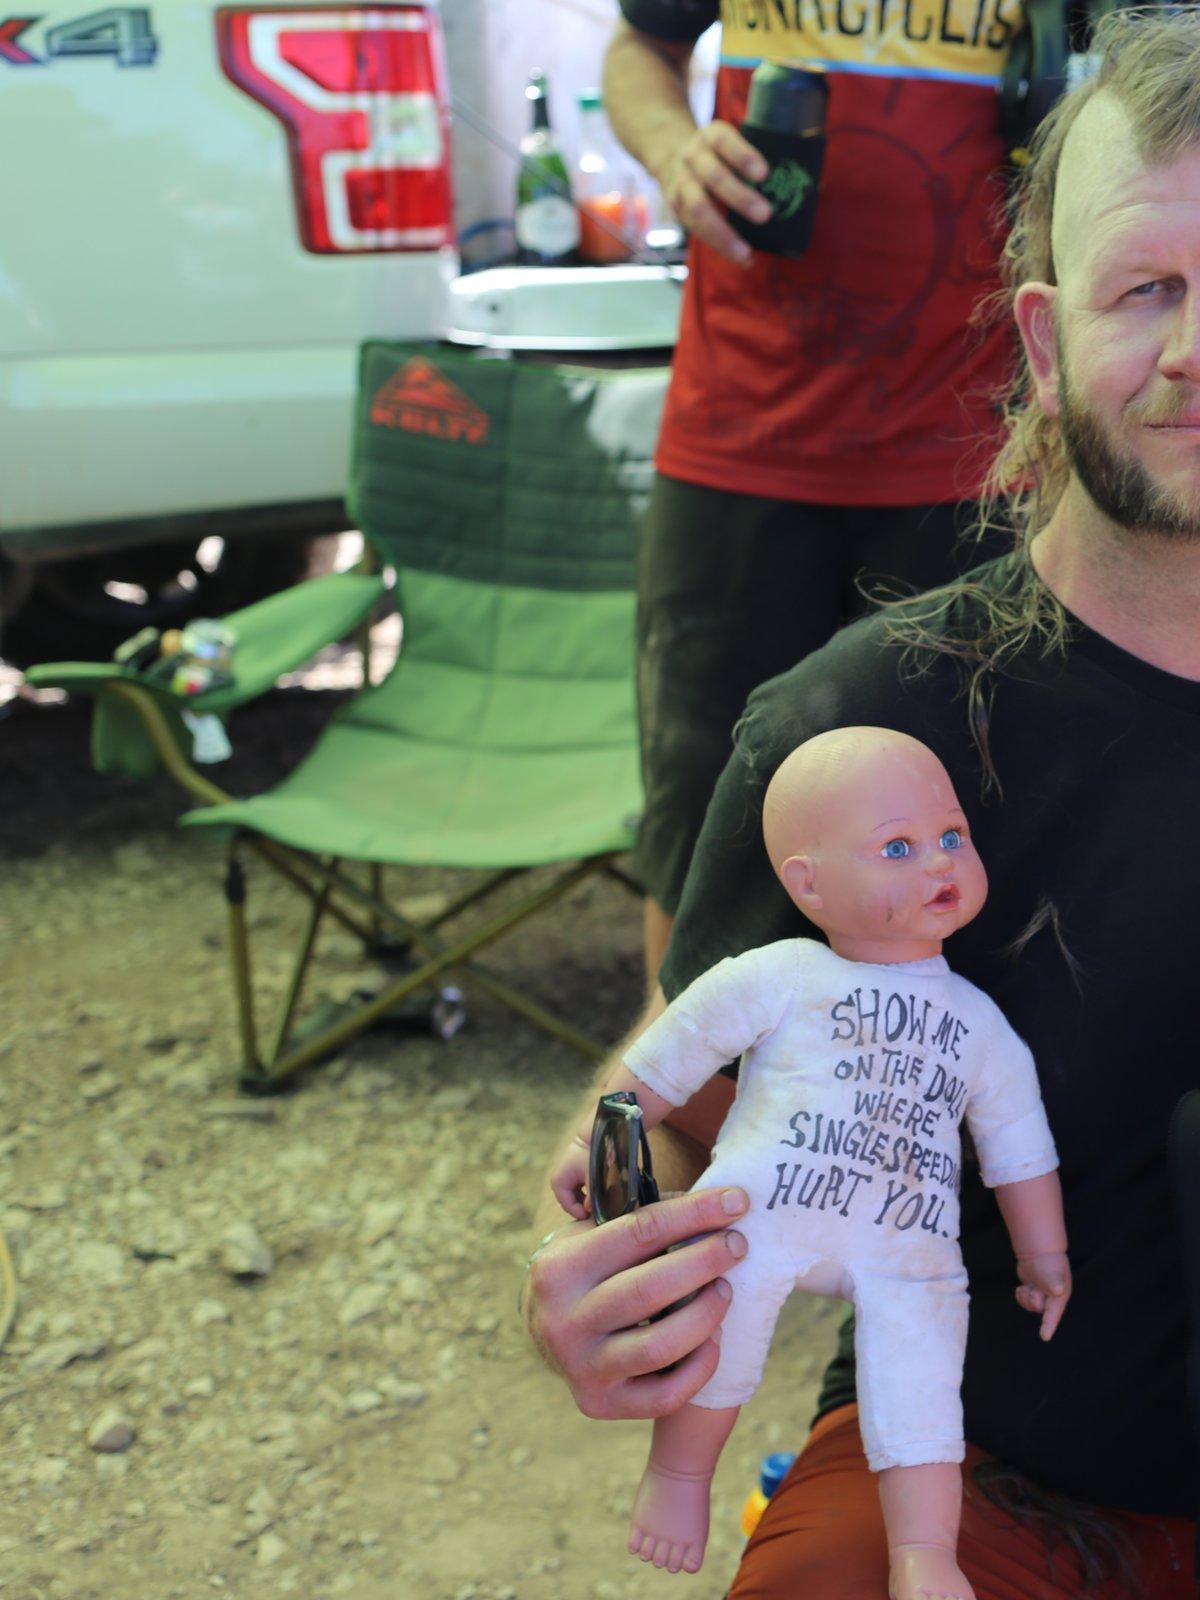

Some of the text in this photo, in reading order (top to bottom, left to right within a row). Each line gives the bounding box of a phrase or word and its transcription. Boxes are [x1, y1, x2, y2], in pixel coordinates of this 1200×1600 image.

[831, 987, 969, 1061] SHOW ME
[834, 1054, 875, 1081] ON
[879, 1047, 923, 1087] THE
[854, 1090, 940, 1138] WHERE
[766, 1162, 948, 1238] HURT YOU.
